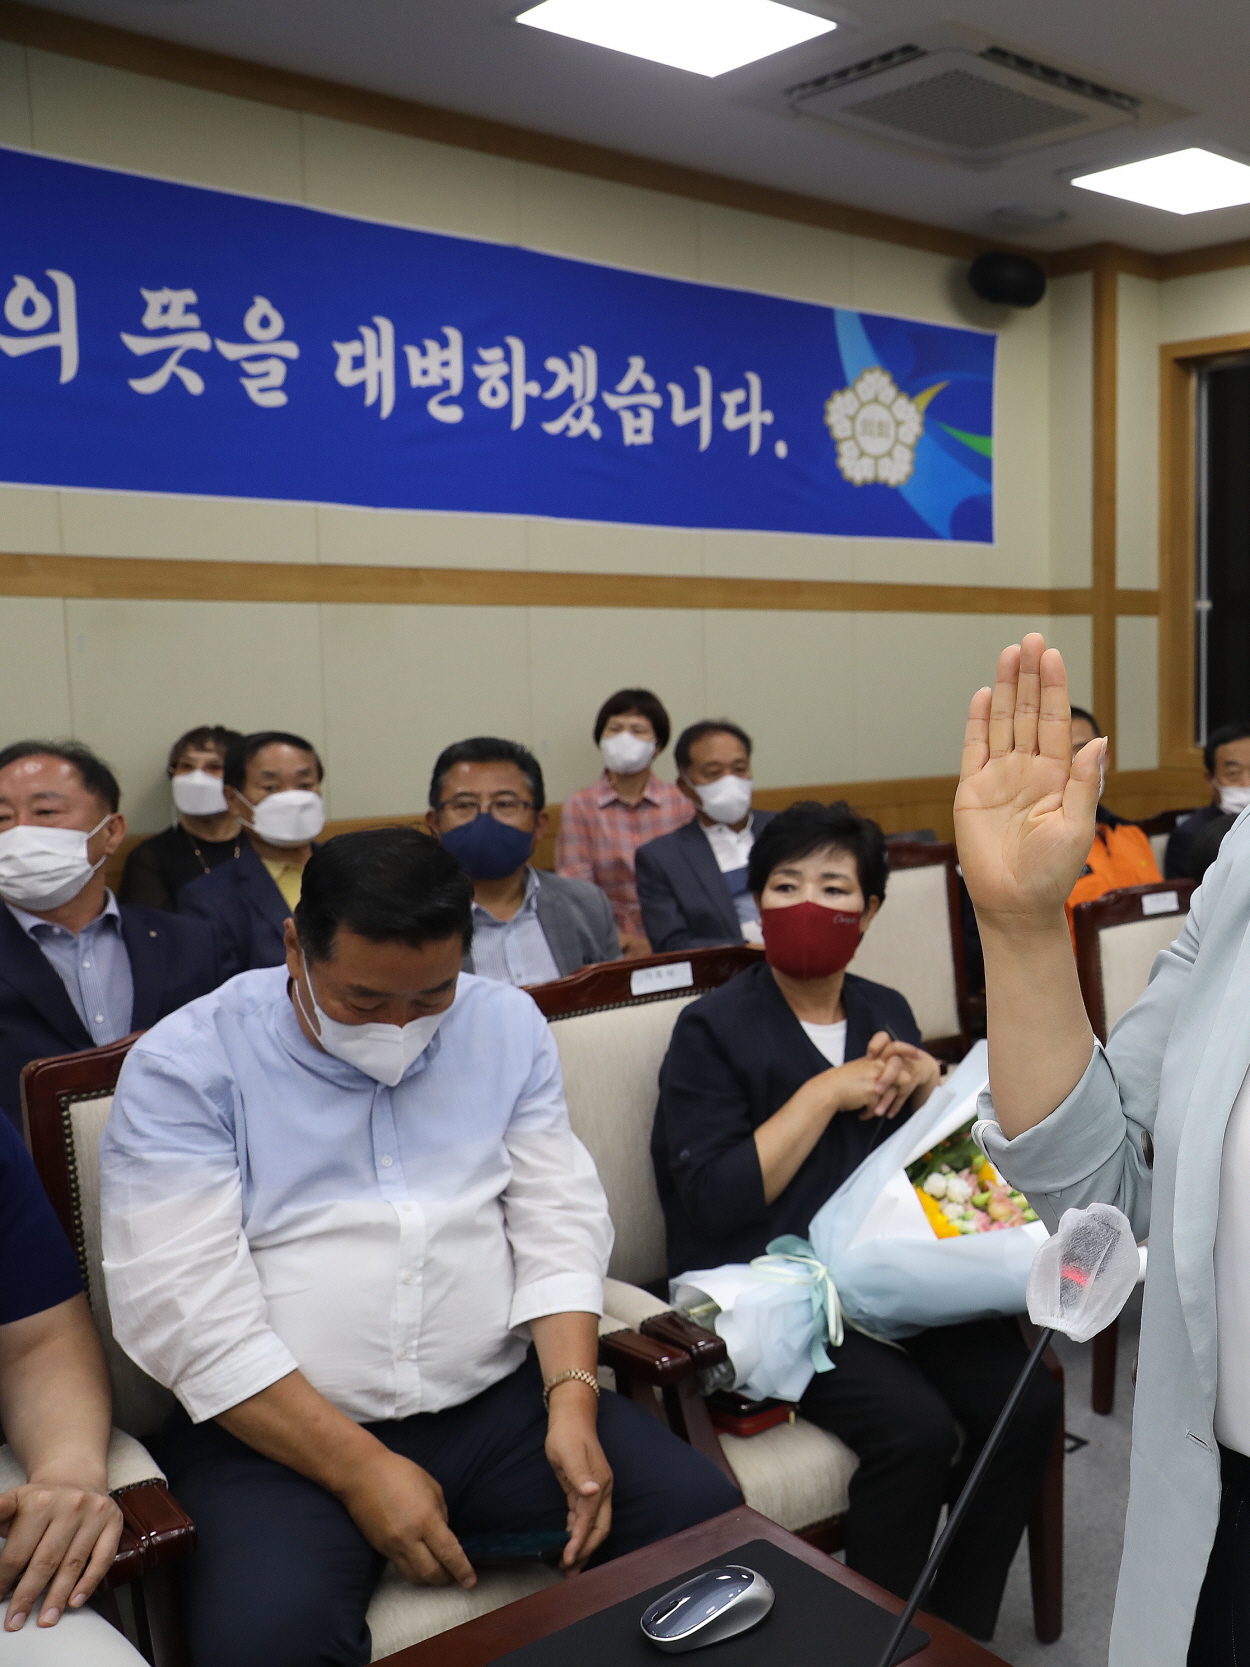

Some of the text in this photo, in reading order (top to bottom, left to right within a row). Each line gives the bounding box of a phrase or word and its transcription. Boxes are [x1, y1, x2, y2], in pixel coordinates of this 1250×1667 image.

[0, 269, 788, 459] 의 뜻을 대변하겠습니다.
